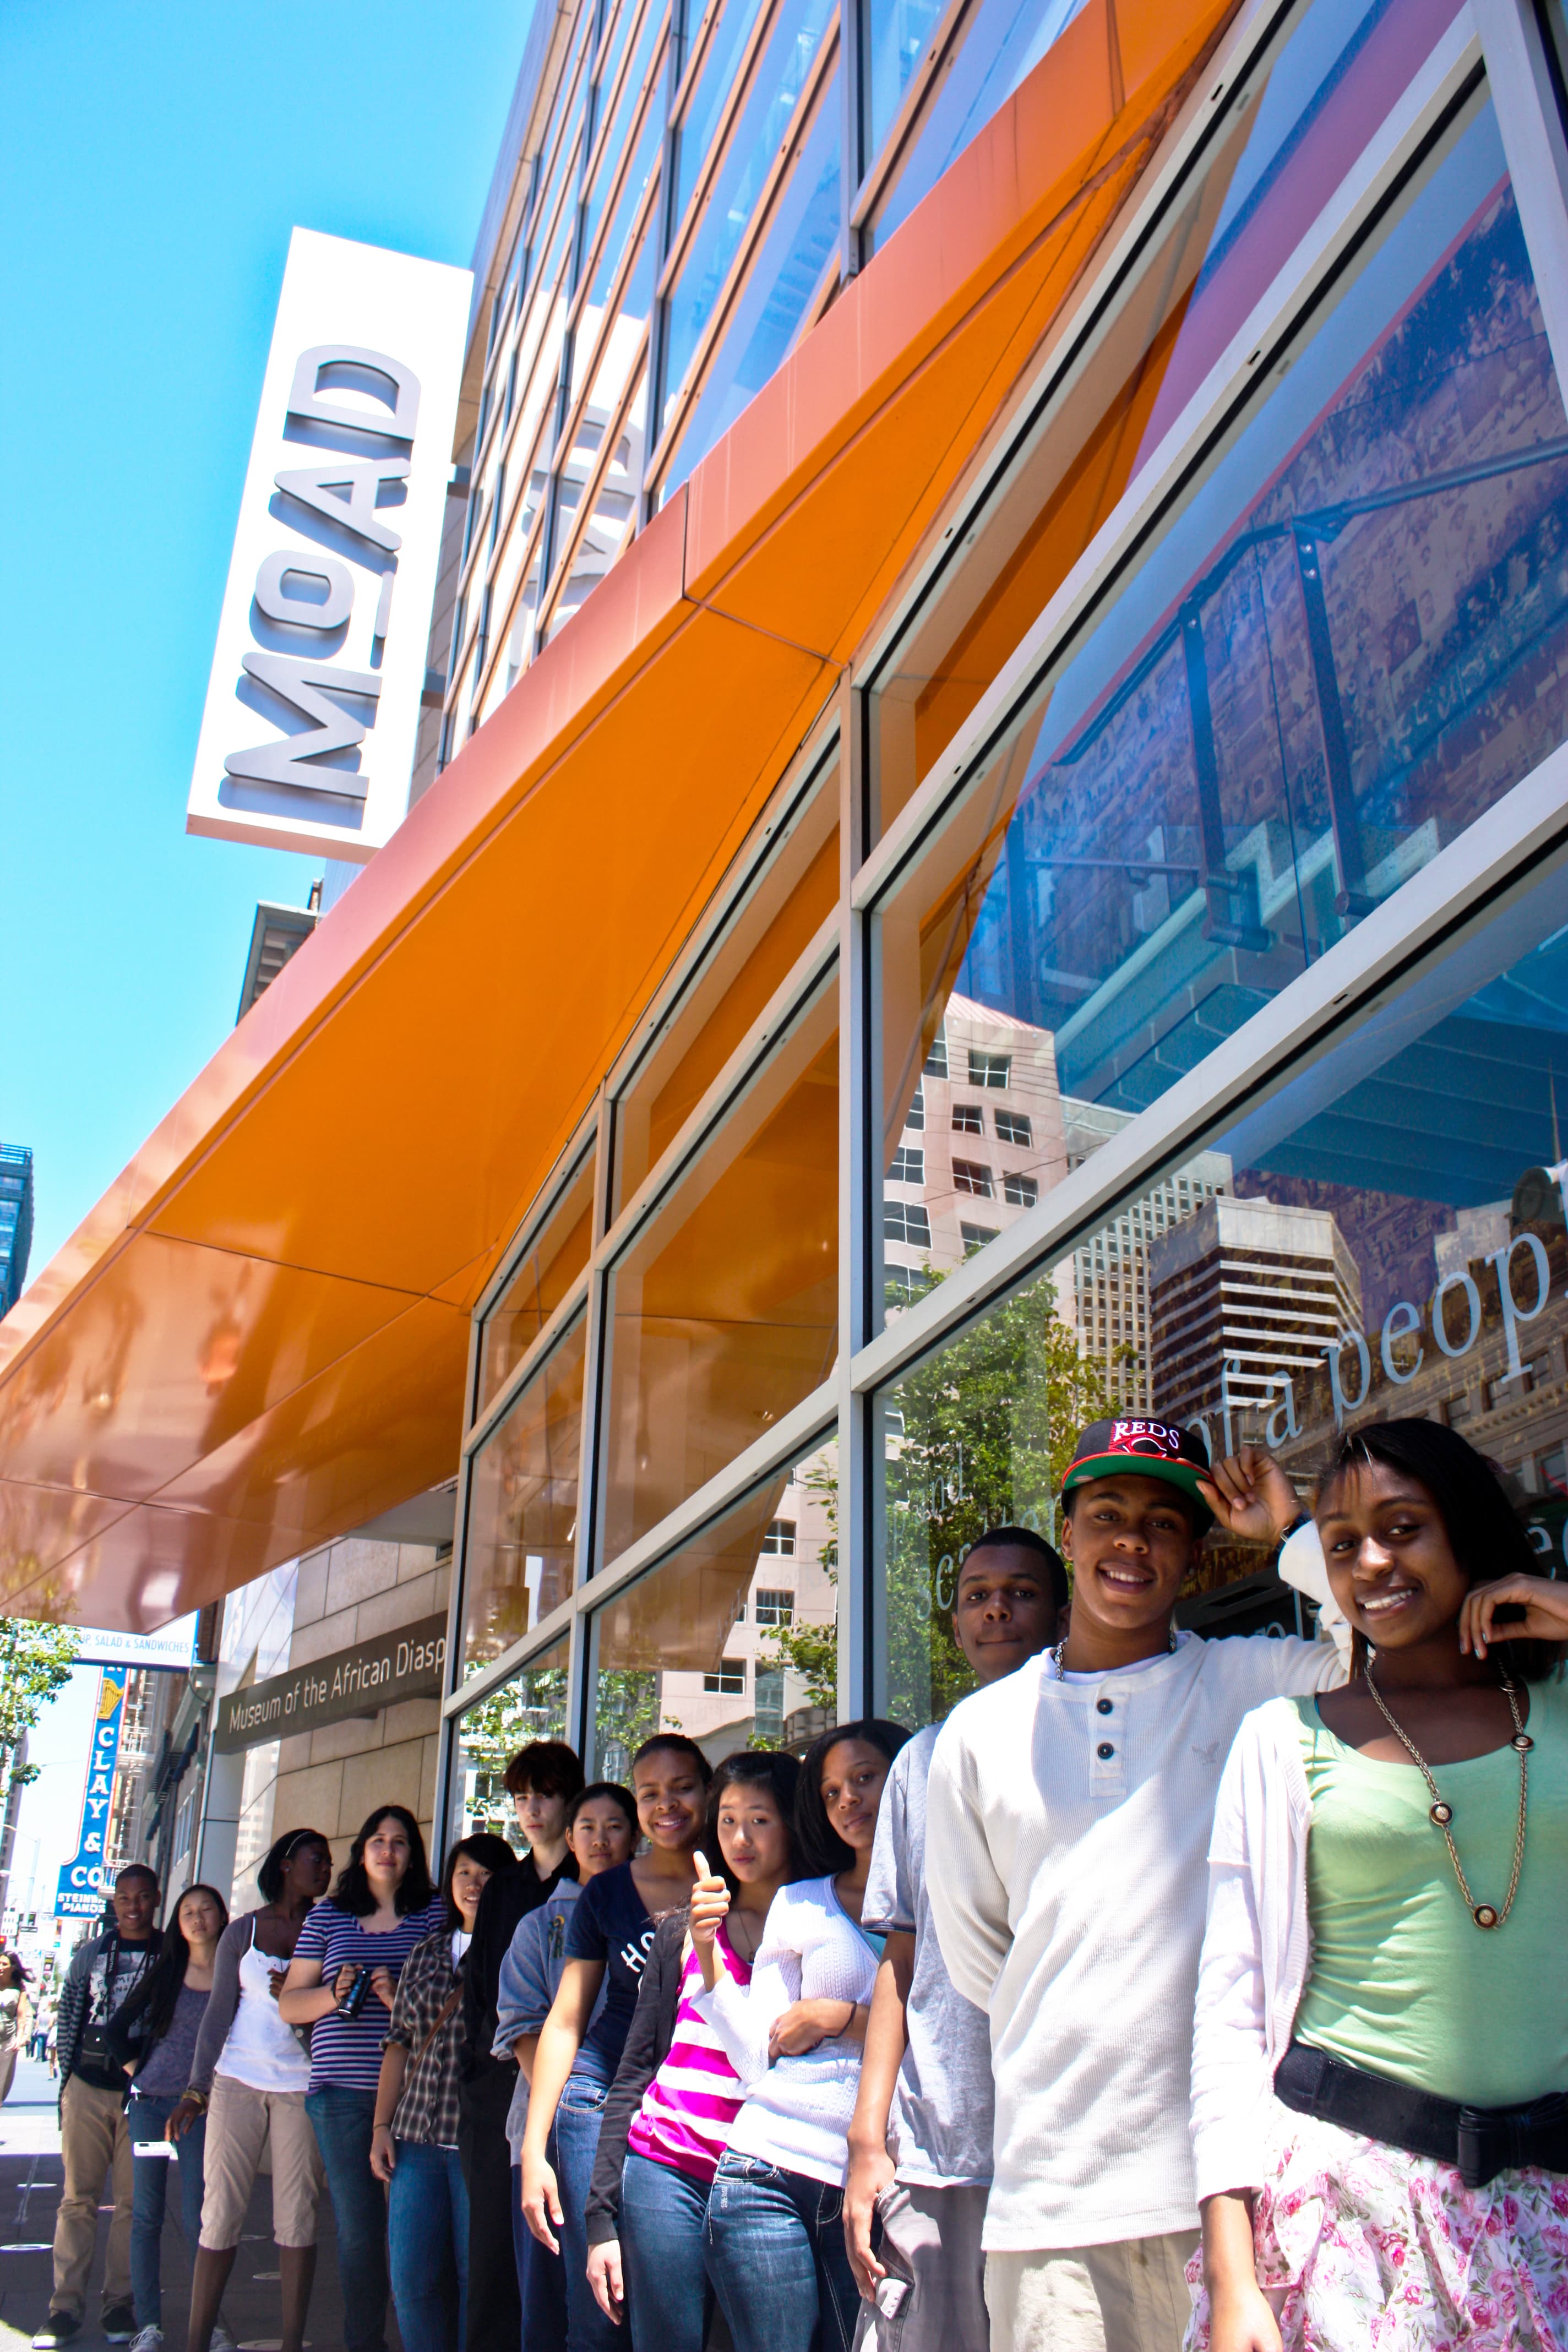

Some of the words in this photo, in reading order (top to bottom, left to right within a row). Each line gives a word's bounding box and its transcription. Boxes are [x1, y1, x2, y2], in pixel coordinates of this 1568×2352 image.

[1266, 1370, 1303, 1449] a
[1321, 1159, 1568, 1433] peop
[1113, 1422, 1179, 1449] REDS
[95, 1635, 122, 1647] SALAD
[134, 1637, 190, 1653] SANDWICHES
[228, 1696, 281, 1734] Museum
[285, 1681, 300, 1715] of
[303, 1676, 327, 1708] the
[330, 1657, 391, 1700] African
[395, 1637, 447, 1678] Diasp
[89, 1727, 115, 1819] CLAY
[84, 1832, 101, 1853] &
[62, 1902, 106, 1914] PIANOS
